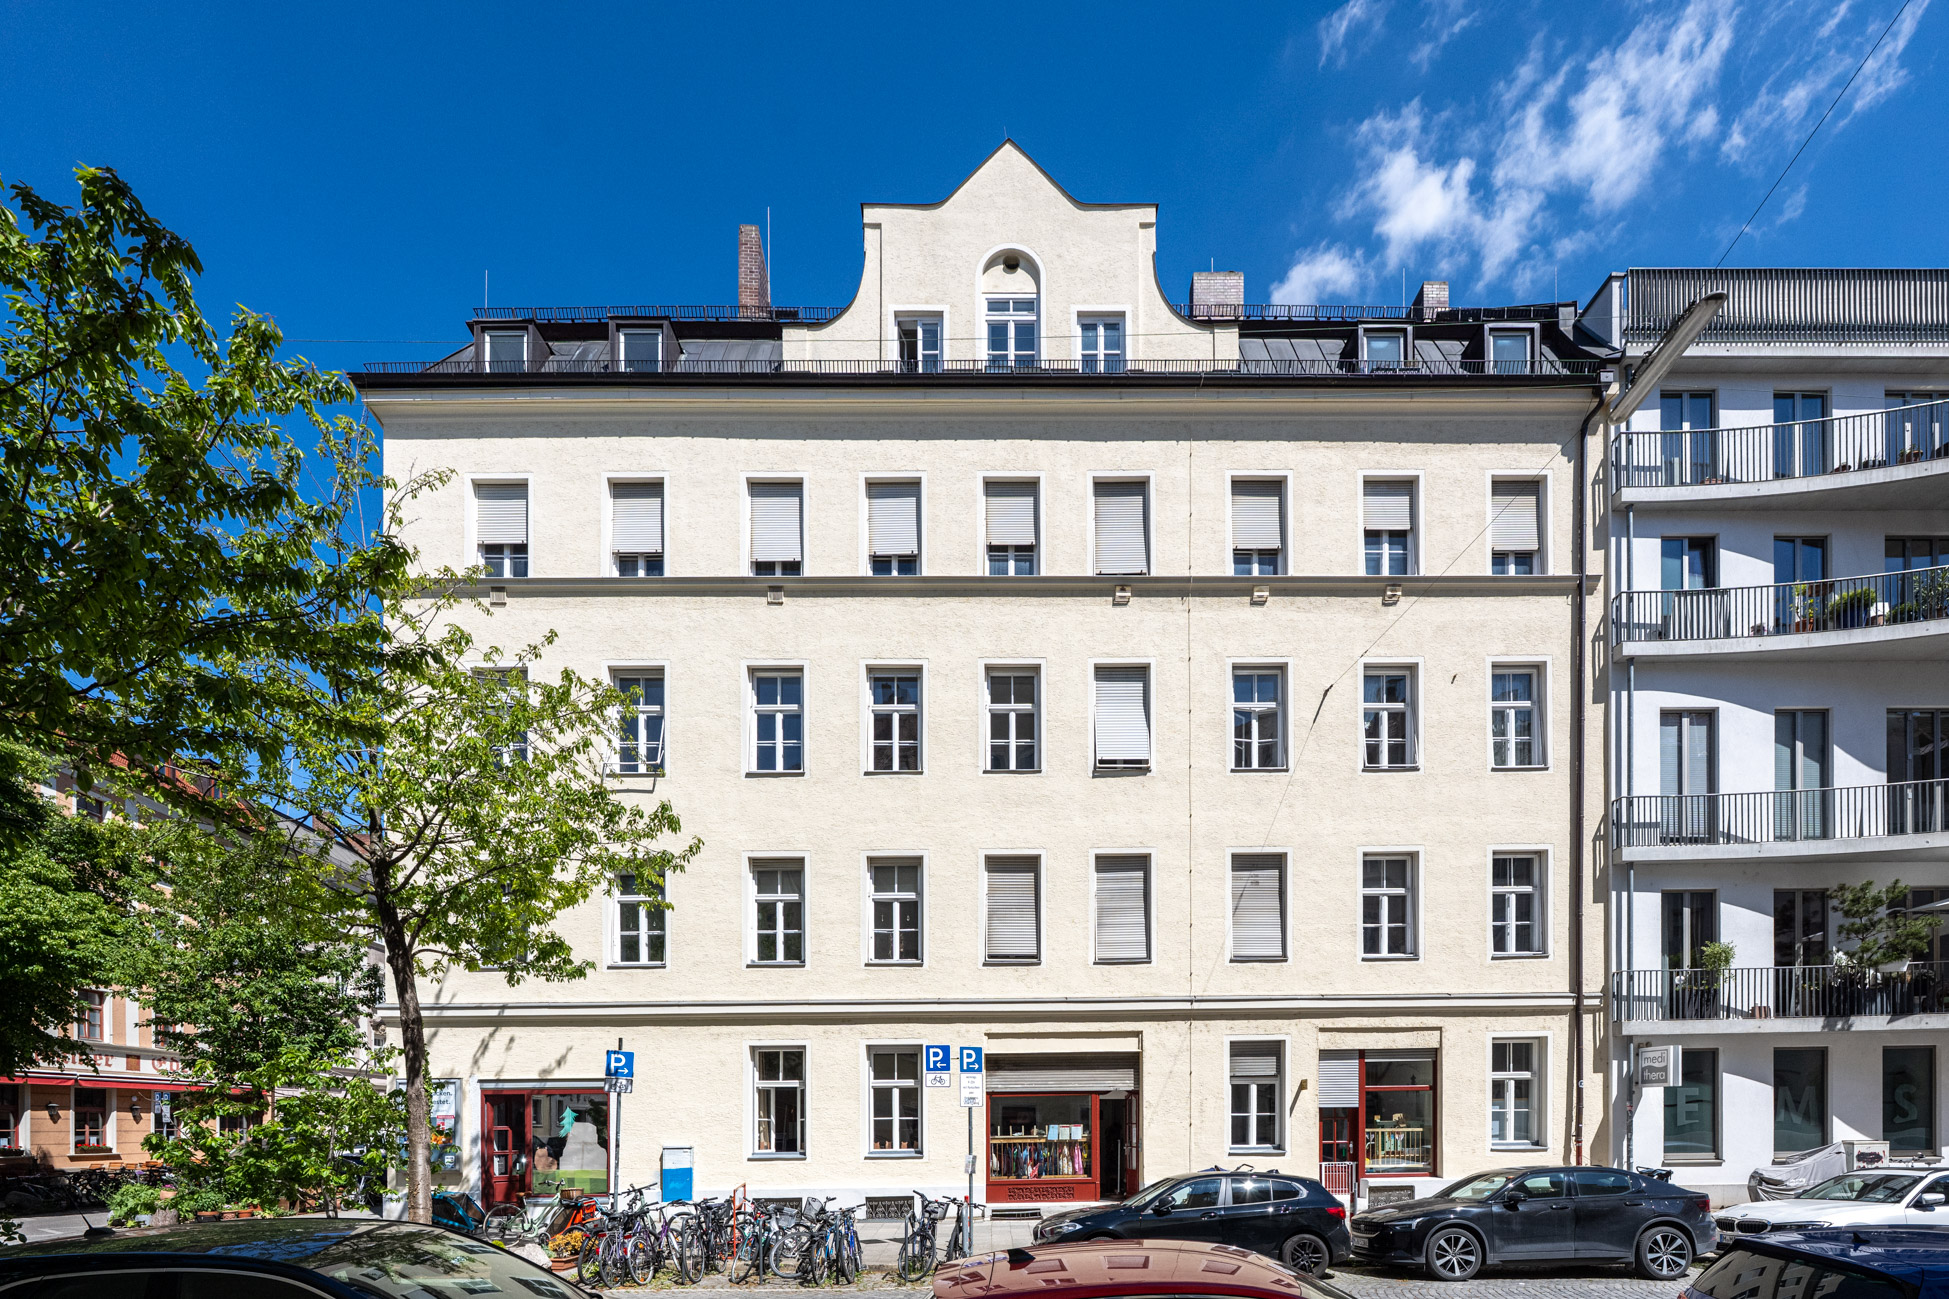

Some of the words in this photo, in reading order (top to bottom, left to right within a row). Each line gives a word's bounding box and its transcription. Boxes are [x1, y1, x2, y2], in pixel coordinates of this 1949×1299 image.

[610, 1053, 626, 1074] P
[929, 1048, 943, 1069] P
[963, 1049, 976, 1070] P
[1643, 1052, 1666, 1064] medi
[1643, 1069, 1666, 1080] thera
